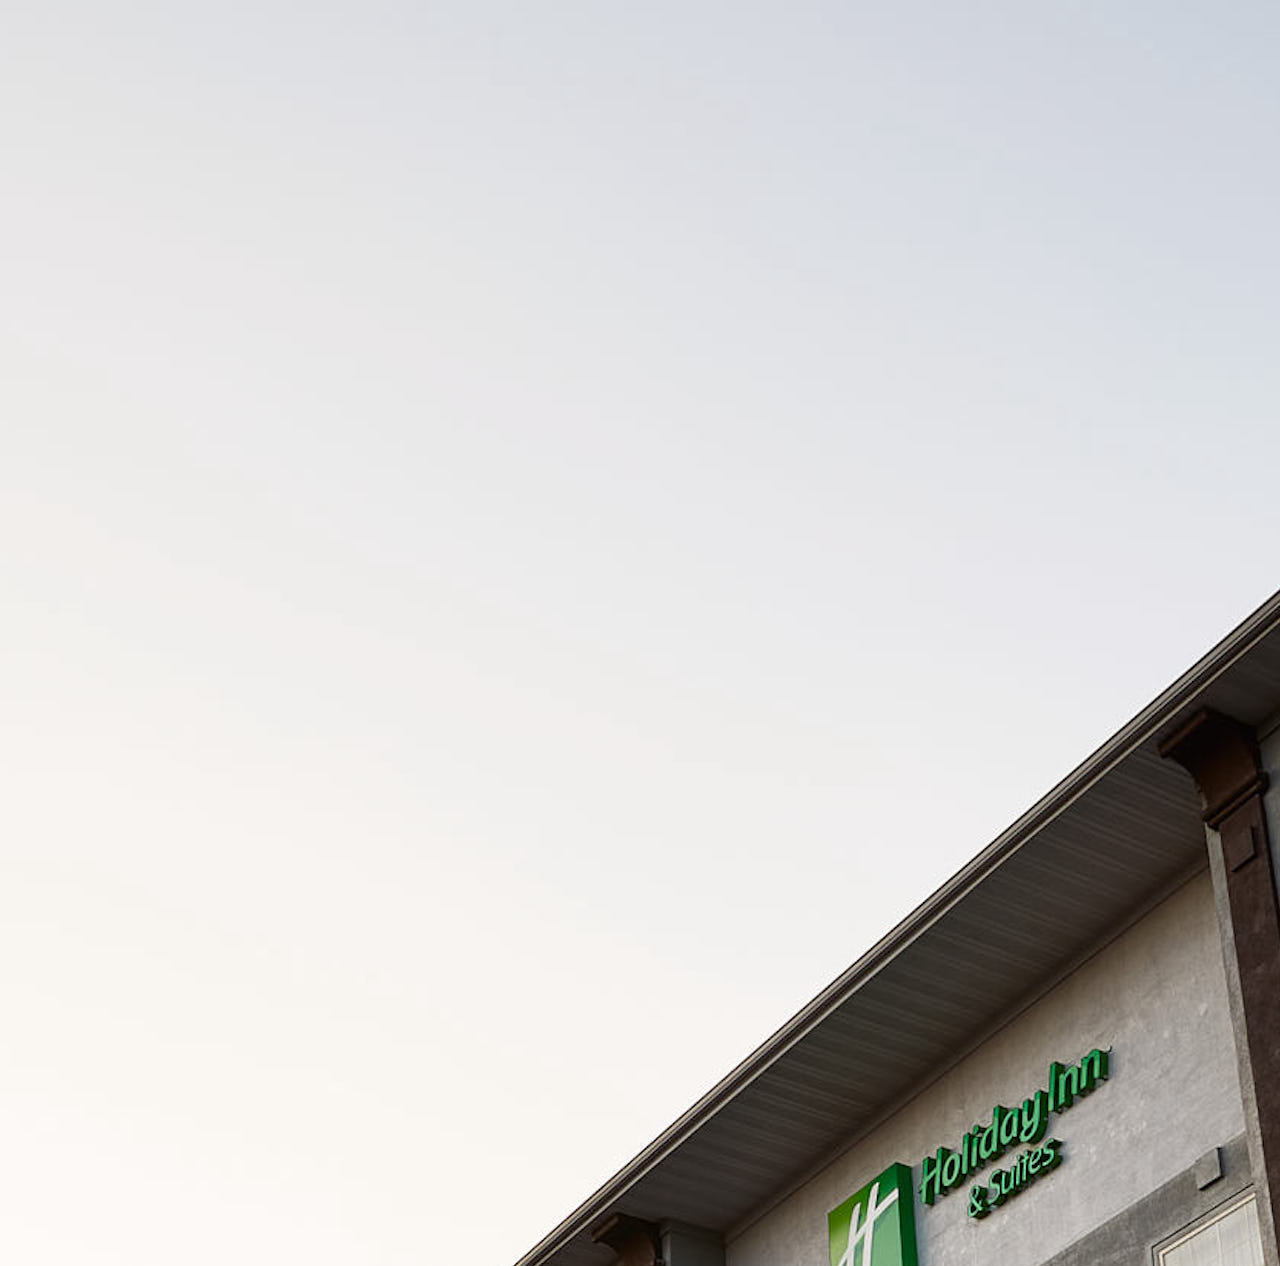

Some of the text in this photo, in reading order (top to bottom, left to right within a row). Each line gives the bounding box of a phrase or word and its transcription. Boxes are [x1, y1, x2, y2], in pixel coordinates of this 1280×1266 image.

[919, 1048, 1109, 1206] Holiday Inn
[968, 1138, 1063, 1219] & Suites
